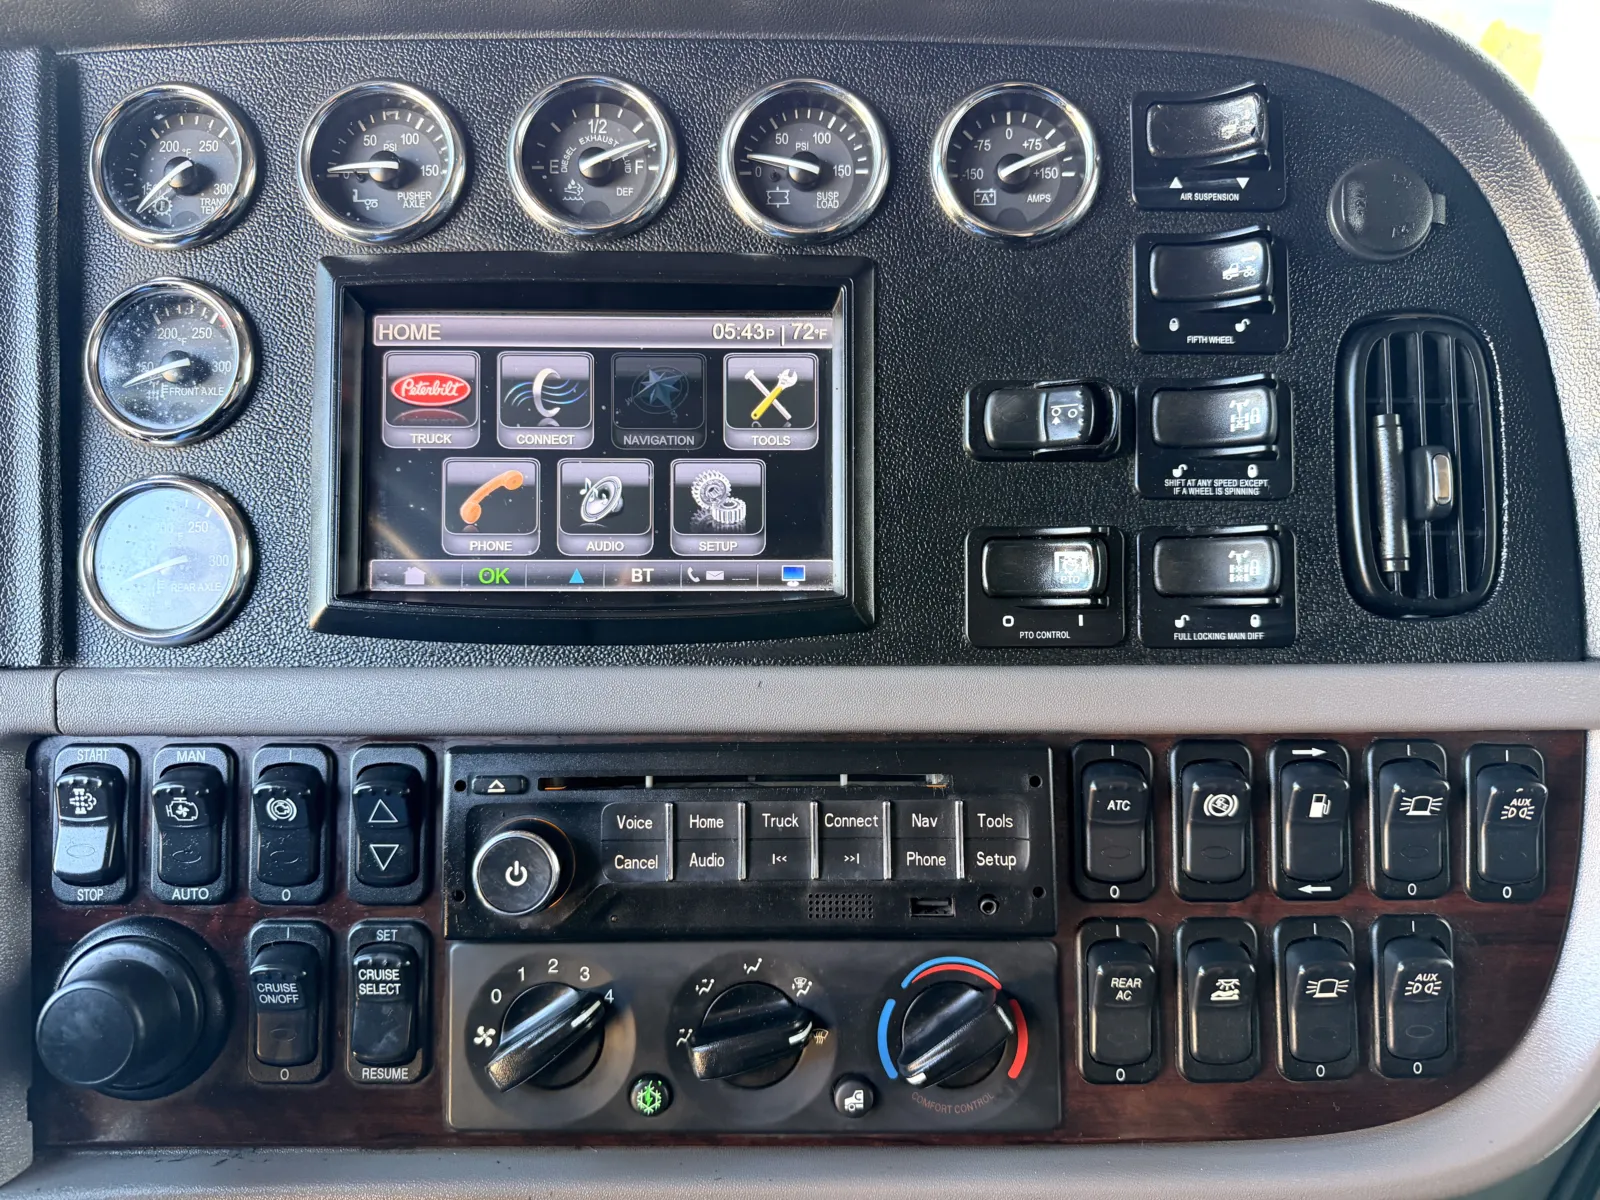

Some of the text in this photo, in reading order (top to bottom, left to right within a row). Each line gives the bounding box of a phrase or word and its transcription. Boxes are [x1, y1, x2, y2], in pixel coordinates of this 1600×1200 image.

[588, 119, 607, 133] 1/2
[363, 135, 377, 146] 50
[401, 133, 419, 144] 100
[775, 133, 788, 144] 50
[813, 133, 831, 144] 100
[159, 141, 179, 152] 200
[199, 141, 218, 151] 250
[974, 140, 991, 151] -75
[1022, 139, 1042, 150] +75
[561, 146, 576, 173] DIESEL
[578, 135, 619, 147] EXHAUST
[421, 165, 439, 176] 150
[635, 160, 644, 174] F
[833, 165, 851, 176] 150
[962, 169, 983, 180] -150
[1034, 168, 1058, 179] +150
[398, 191, 431, 199] PUSHER
[617, 188, 634, 196] DEF
[817, 192, 839, 200] SUSP
[1194, 193, 1239, 201] SUSPENSION
[1027, 194, 1051, 203] AMPS
[157, 328, 177, 339] 200
[192, 328, 212, 338] 250
[379, 324, 441, 341] HOME
[1209, 336, 1235, 344] WHEEL
[212, 361, 231, 372] 300
[169, 387, 224, 396] FRONT AXLE
[401, 378, 464, 397] Peterbilt
[410, 433, 452, 444] TRUCK
[516, 434, 575, 445] CONNECT
[623, 435, 695, 446] NAVIGATION
[751, 436, 791, 446] TOOLS
[1239, 479, 1268, 487] EXCEPT
[188, 521, 208, 533] 250
[469, 541, 512, 551] PHONE
[586, 541, 624, 551] AUDIO
[699, 541, 738, 552] SETUP
[209, 555, 229, 567] 300
[479, 567, 510, 584] OK
[631, 568, 654, 582] BT
[171, 583, 222, 592] REAR AXLE
[1036, 631, 1070, 639] CONTROL
[77, 750, 109, 761] START
[177, 751, 206, 761] MAN
[1107, 800, 1131, 811] ATC
[1510, 798, 1532, 806] AUX
[617, 815, 653, 829] Voice
[689, 814, 724, 829] Home
[762, 813, 799, 828] Truck
[825, 813, 878, 828] Connect
[912, 814, 938, 828] Nav
[977, 813, 1013, 828] Tools
[615, 855, 658, 869] Cancel
[689, 853, 725, 867] Audio
[906, 852, 946, 866] Phone
[976, 852, 1017, 870] Setup
[77, 889, 103, 900] STOP
[172, 888, 209, 900] AUTO
[377, 930, 398, 941] SET
[548, 959, 559, 973] 2
[358, 969, 400, 980] CRUISE
[517, 967, 525, 982] 1
[579, 966, 590, 982] 3
[1415, 973, 1438, 981] AUX
[257, 983, 298, 992] CRUISE
[1111, 978, 1142, 988] REAR
[359, 983, 401, 995] SELECT
[259, 995, 299, 1004] ON/OFF
[491, 989, 502, 1004] 0
[604, 989, 614, 1003] 4
[1116, 990, 1132, 1000] AC
[362, 1068, 408, 1079] RESUME
[912, 1091, 995, 1114] COMFORT CONTROL
